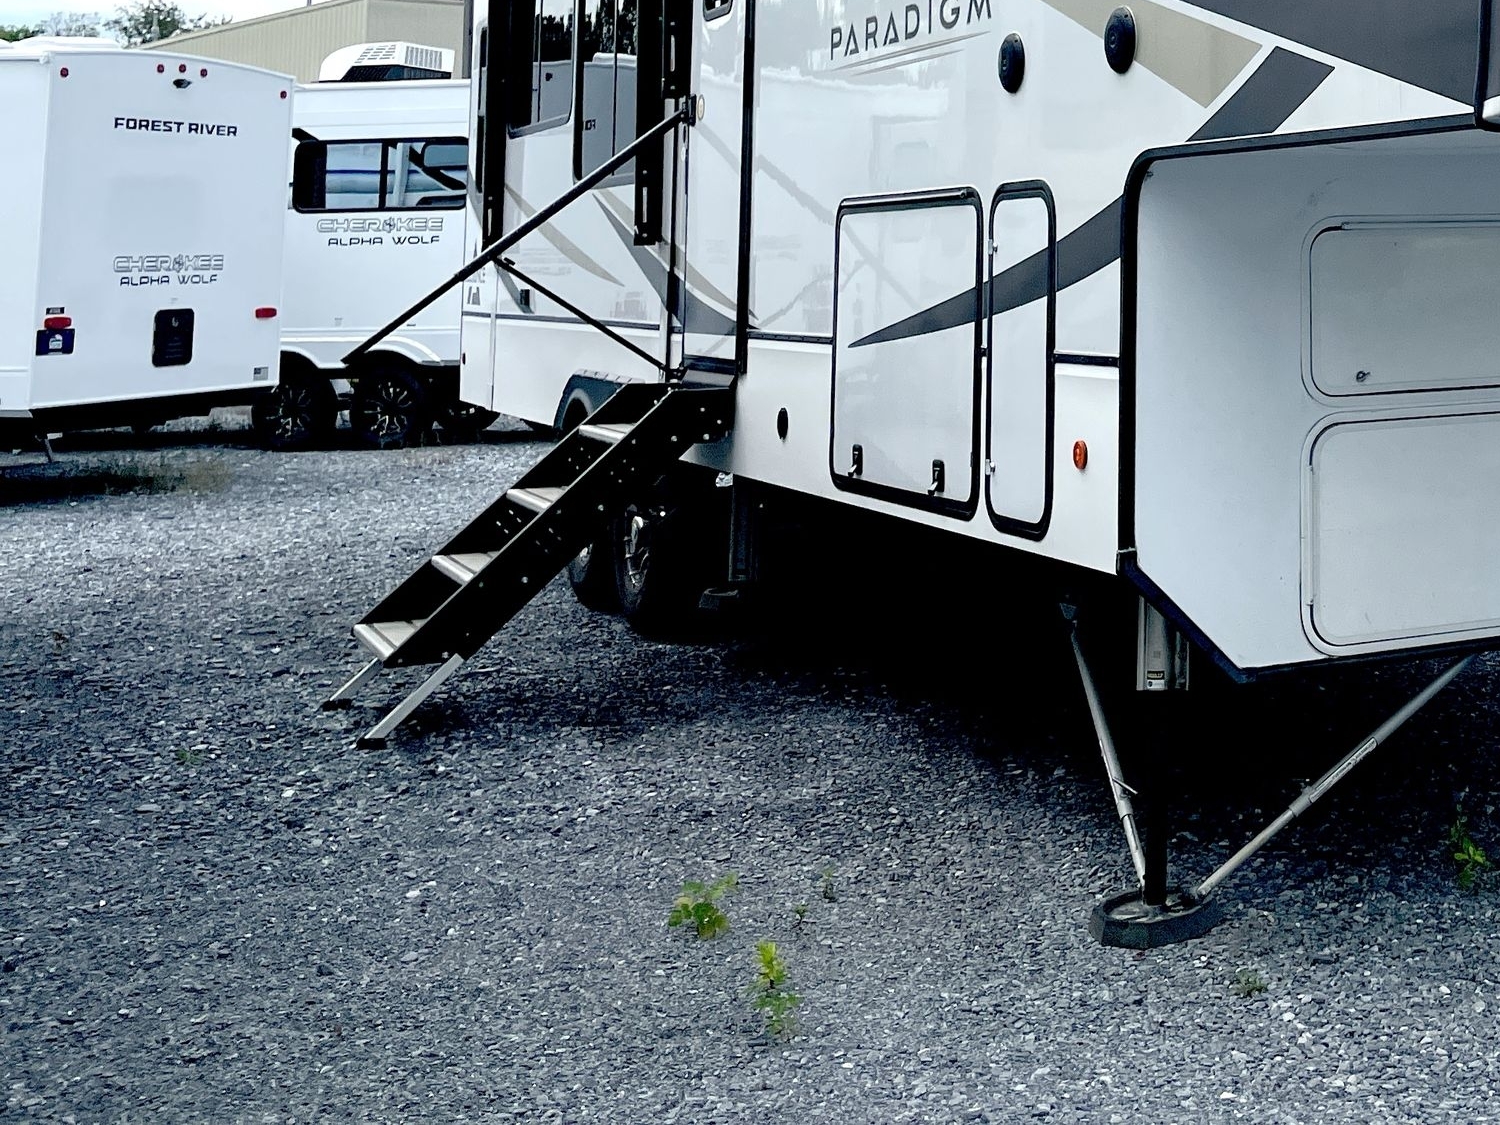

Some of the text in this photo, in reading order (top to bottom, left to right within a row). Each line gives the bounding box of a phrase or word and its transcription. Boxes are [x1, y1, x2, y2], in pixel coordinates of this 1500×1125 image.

[114, 117, 238, 137] FOREST RIVER
[328, 235, 440, 247] ALPHA WOLF
[120, 274, 218, 287] ALPHA WOLF
